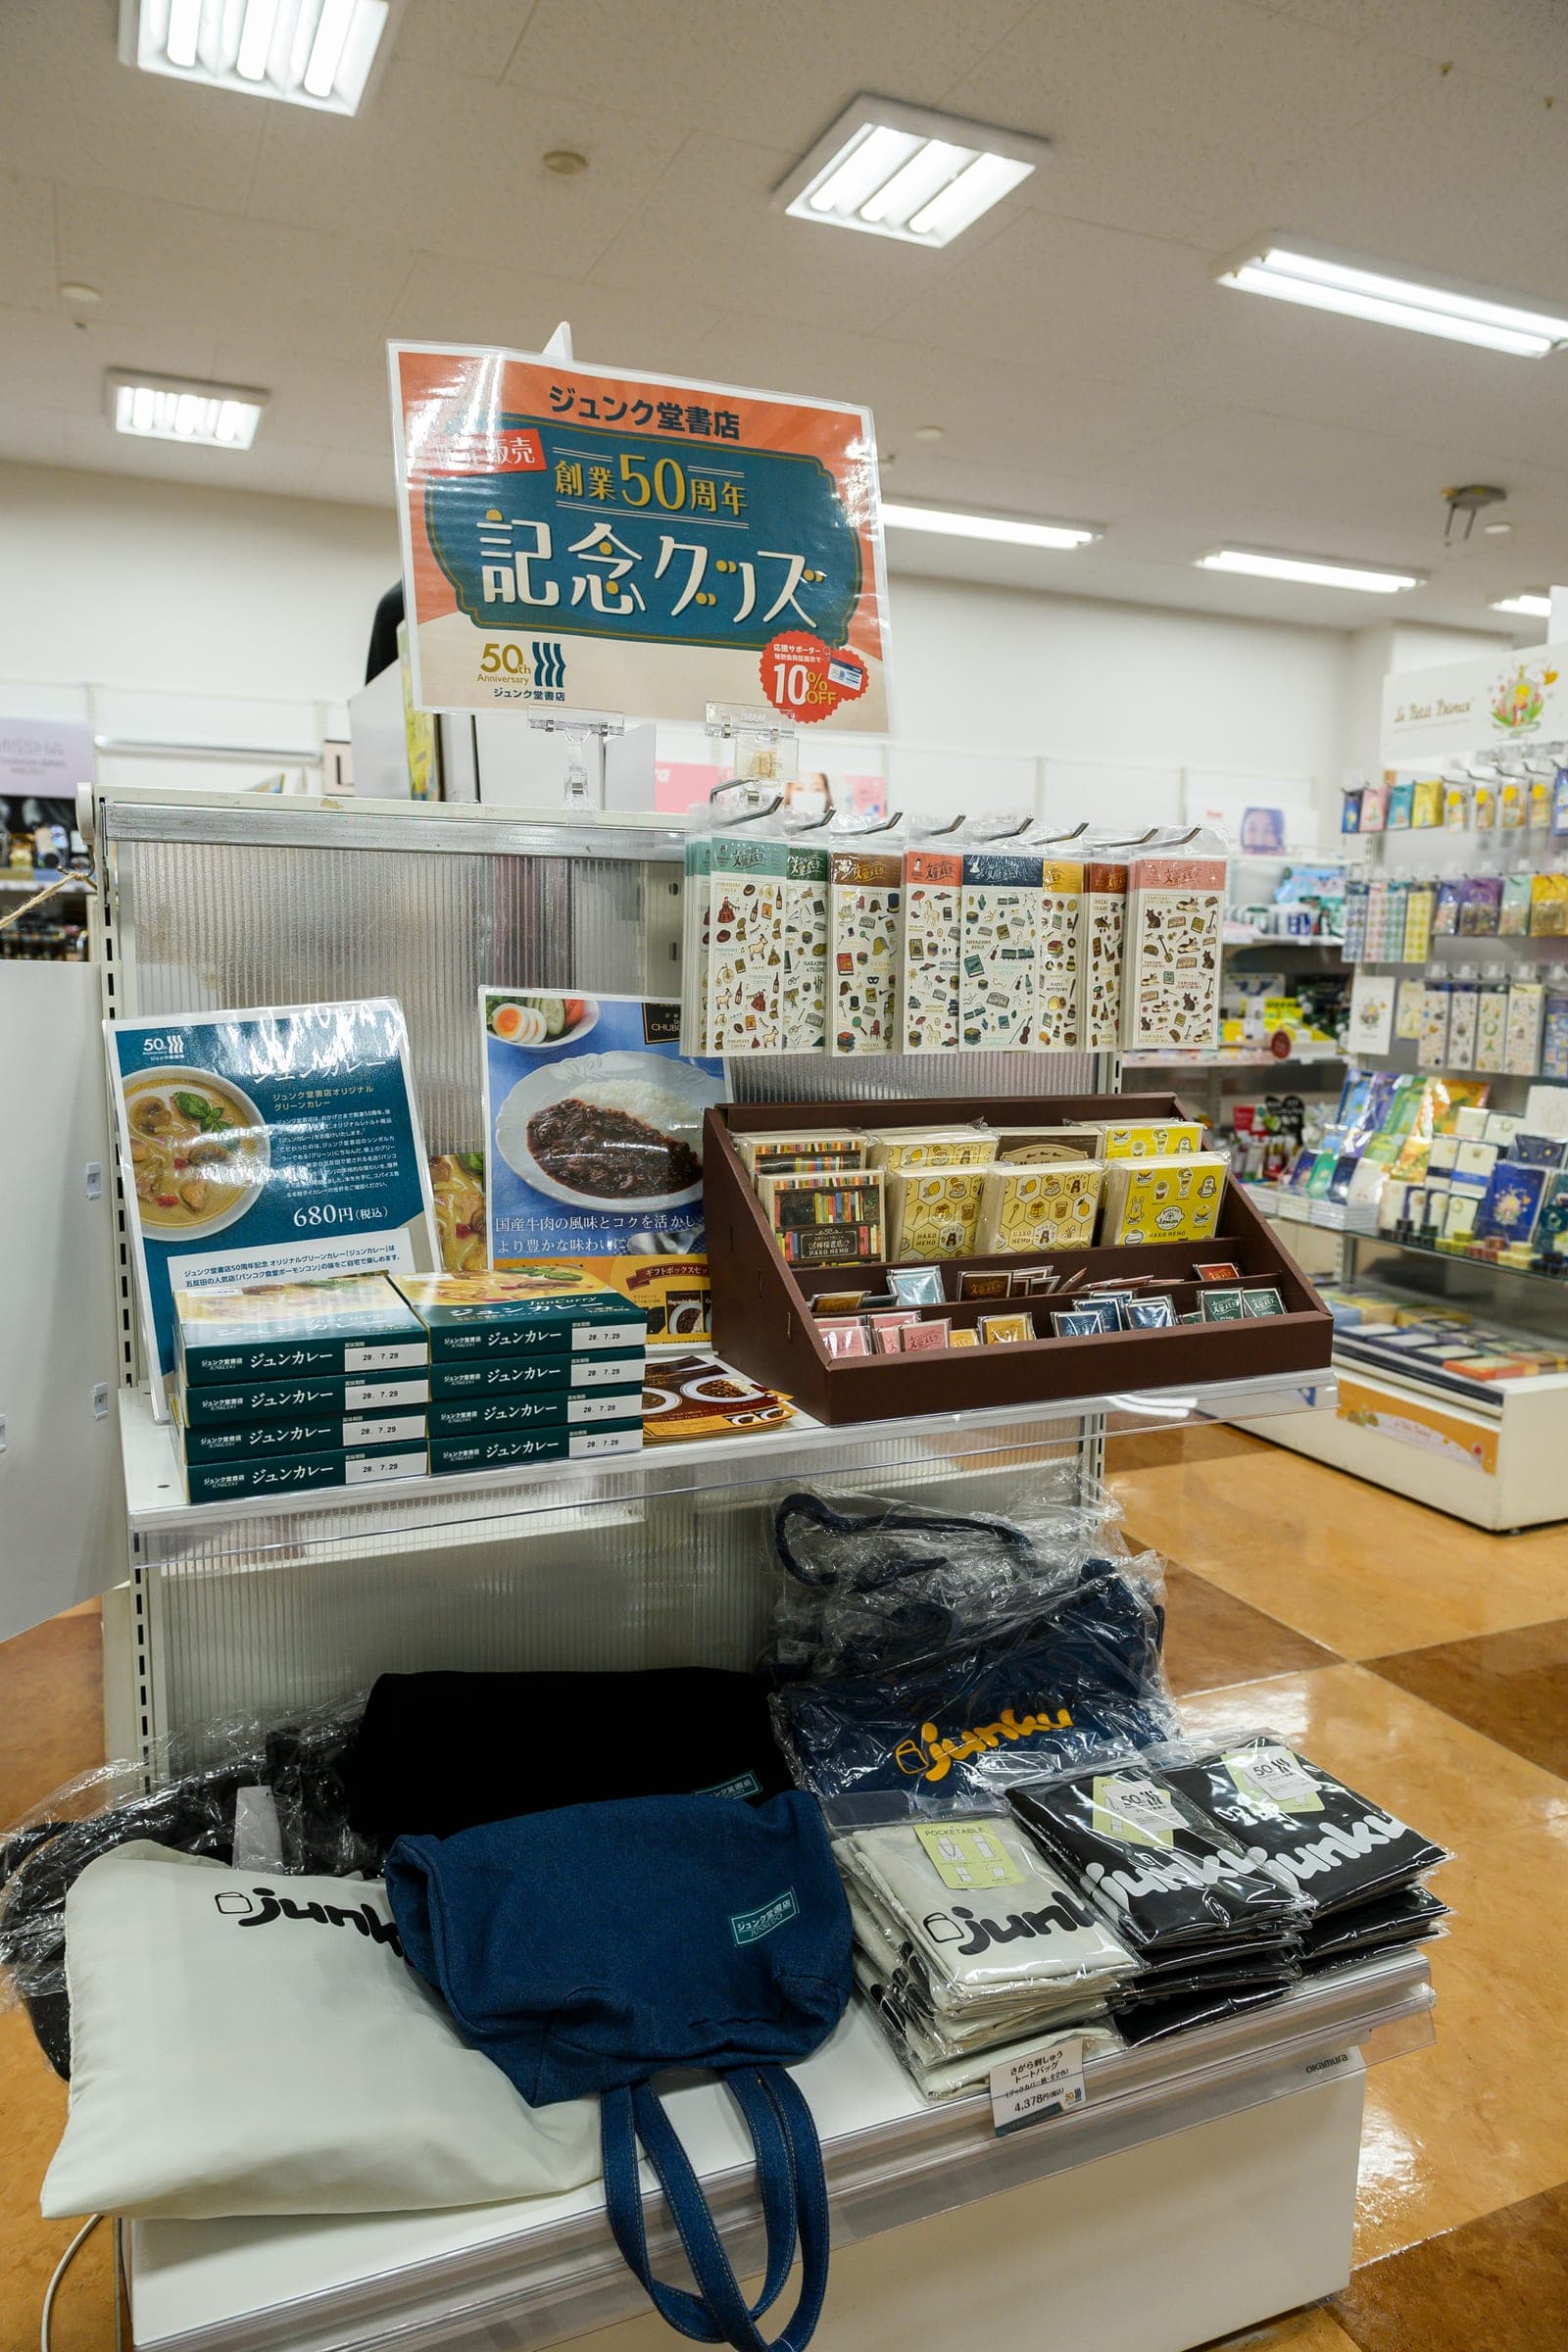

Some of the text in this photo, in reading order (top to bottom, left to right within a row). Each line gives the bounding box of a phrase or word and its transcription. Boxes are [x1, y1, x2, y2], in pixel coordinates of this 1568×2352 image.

[549, 384, 740, 441] ジュンク堂書店
[554, 454, 749, 516] 創業50周年
[476, 509, 827, 628] 記念グッズ
[476, 673, 529, 686] Anniversary
[493, 687, 565, 702] ジュンク堂書店
[806, 692, 837, 706] OFF
[273, 1086, 374, 1102] ジュンク堂書店オリジナル
[273, 1101, 331, 1112] グリーンカレー
[488, 1330, 562, 1347] ジュンカレー
[251, 1351, 333, 1368] ジュンカレー
[487, 1366, 561, 1383] ジュンカレー
[251, 1390, 333, 1408] ジュンカレー
[484, 1403, 558, 1421] ジュンカレー
[249, 1427, 331, 1445] ジュンカレー
[486, 1441, 559, 1458] ジュンカレー
[252, 1465, 333, 1484] ジュンカレー
[1015, 2060, 1059, 2084] トートバッグ
[1305, 2053, 1348, 2074] okamura
